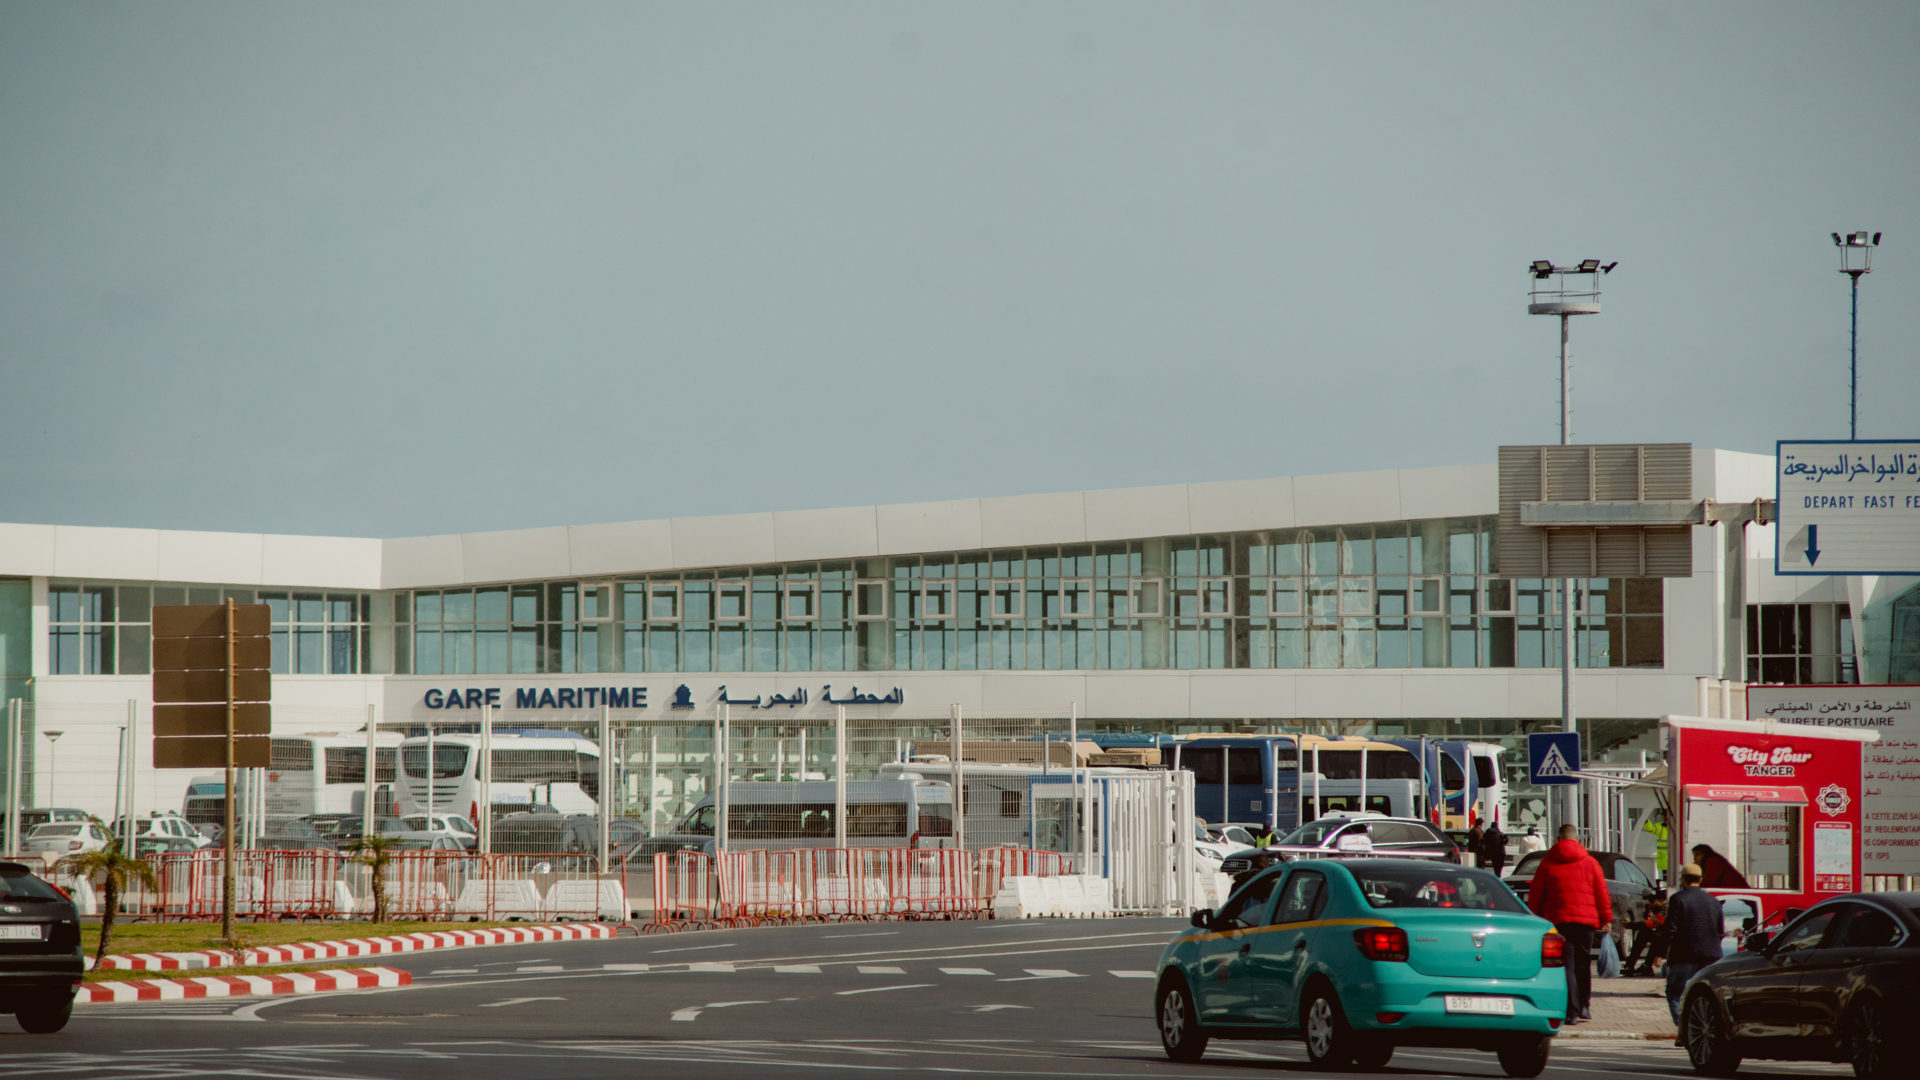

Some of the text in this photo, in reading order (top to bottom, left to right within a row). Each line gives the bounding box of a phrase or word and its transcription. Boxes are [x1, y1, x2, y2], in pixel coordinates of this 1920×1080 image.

[1804, 495, 1855, 508] DEPART
[1864, 495, 1895, 508] FAST
[424, 687, 648, 709] GARE MARITIME
[718, 684, 904, 709] المحطة البحرية
[1863, 700, 1911, 713] الشرطة
[1780, 717, 1895, 727] SURETE PORTUAIRE
[1727, 745, 1812, 765] City Tour
[1745, 766, 1795, 776] TANGER
[1871, 812, 1890, 820] CETTE
[1892, 812, 1908, 820] ZONE
